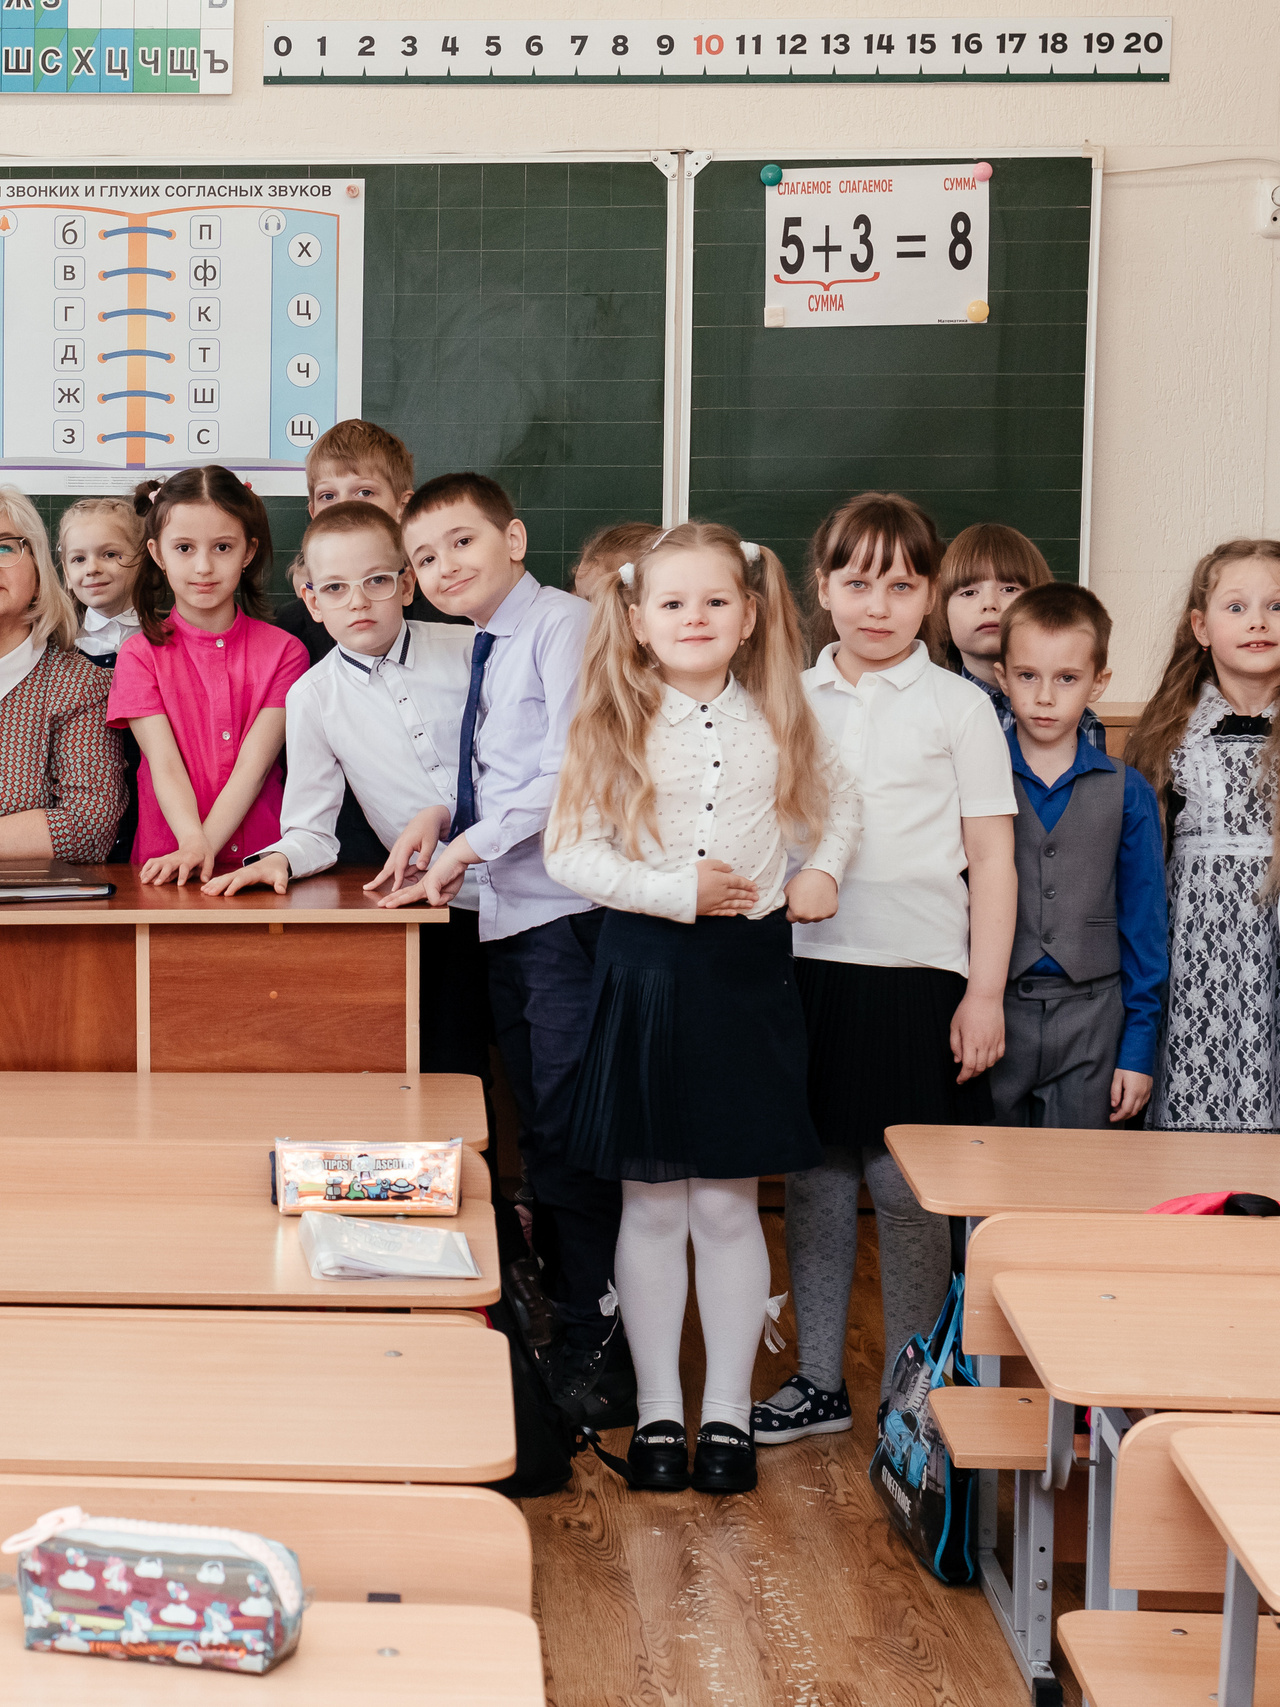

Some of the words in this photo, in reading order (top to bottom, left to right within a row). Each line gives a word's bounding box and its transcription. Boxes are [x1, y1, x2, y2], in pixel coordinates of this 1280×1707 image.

[273, 35, 293, 57] 0
[316, 35, 328, 57] 1
[357, 35, 376, 57] 2
[400, 35, 418, 57] 3
[441, 35, 460, 57] 4
[484, 35, 502, 57] 5
[525, 34, 544, 57] 6
[570, 35, 589, 56] 7
[611, 34, 629, 56] 8
[656, 34, 675, 56] 9
[693, 34, 725, 56] 10
[735, 34, 762, 55] 11
[776, 33, 807, 55] 12
[820, 33, 851, 55] 13
[863, 33, 895, 55] 14
[906, 33, 937, 55] 15
[951, 32, 983, 55] 16
[996, 32, 1027, 54] 17
[1038, 32, 1069, 54] 18
[1083, 32, 1115, 54] 19
[1122, 31, 1164, 54] 20
[5, 184, 82, 199] ЗВОНКИХ
[84, 184, 96, 199] И
[98, 184, 161, 199] ГЛУХИХ
[164, 184, 264, 199] СОГЛАСНЫХ
[267, 184, 332, 199] ЗВУКОВ
[777, 180, 832, 196] СЛАГАЕМОЕ
[838, 178, 894, 194] СЛАГАЕМОЕ
[943, 176, 977, 192] СУММА
[948, 211, 973, 271] 8
[807, 293, 845, 312] СУММА
